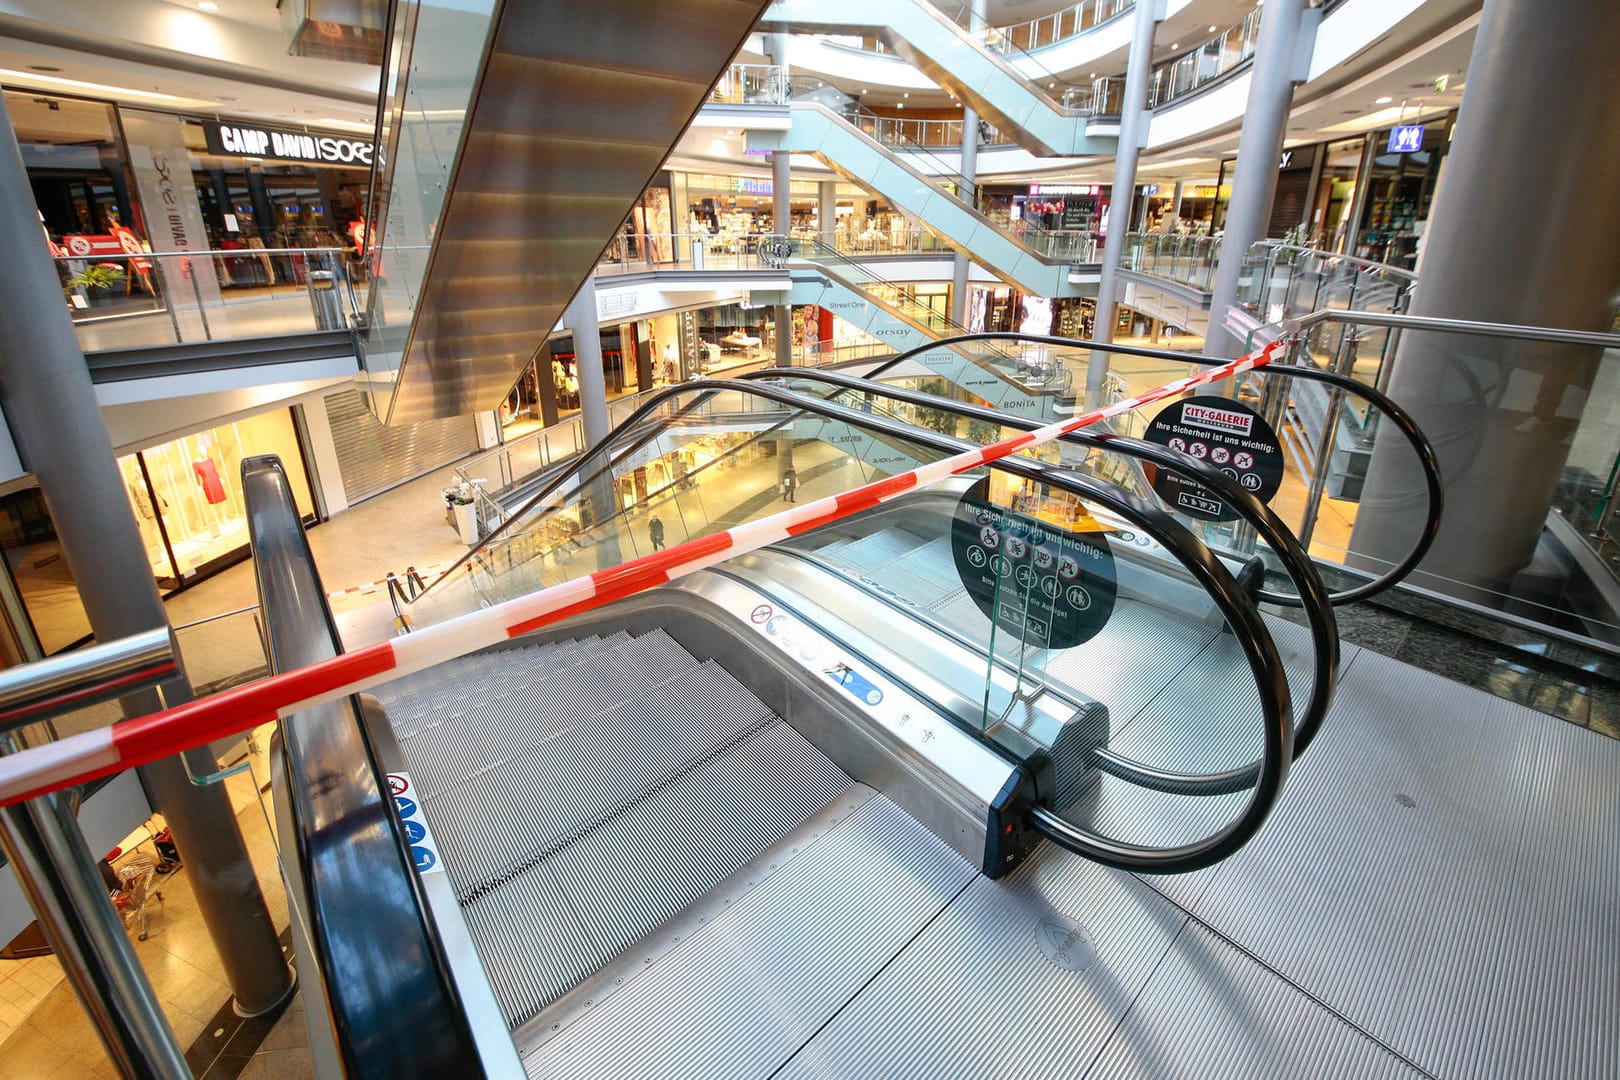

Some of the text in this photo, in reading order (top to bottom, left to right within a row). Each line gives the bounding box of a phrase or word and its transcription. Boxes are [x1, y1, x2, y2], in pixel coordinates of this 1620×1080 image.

[220, 126, 268, 155] CAMP
[271, 132, 316, 159] DAVID
[829, 301, 866, 310] Street One
[1003, 400, 1036, 409] BONITA
[1185, 407, 1249, 427] CITY-GALERIE
[1156, 421, 1275, 453] Ihre Sicherheit ist uns wichtig:
[964, 502, 980, 516] Ihre
[1045, 531, 1062, 545] uns
[1063, 536, 1104, 560] wichtig:
